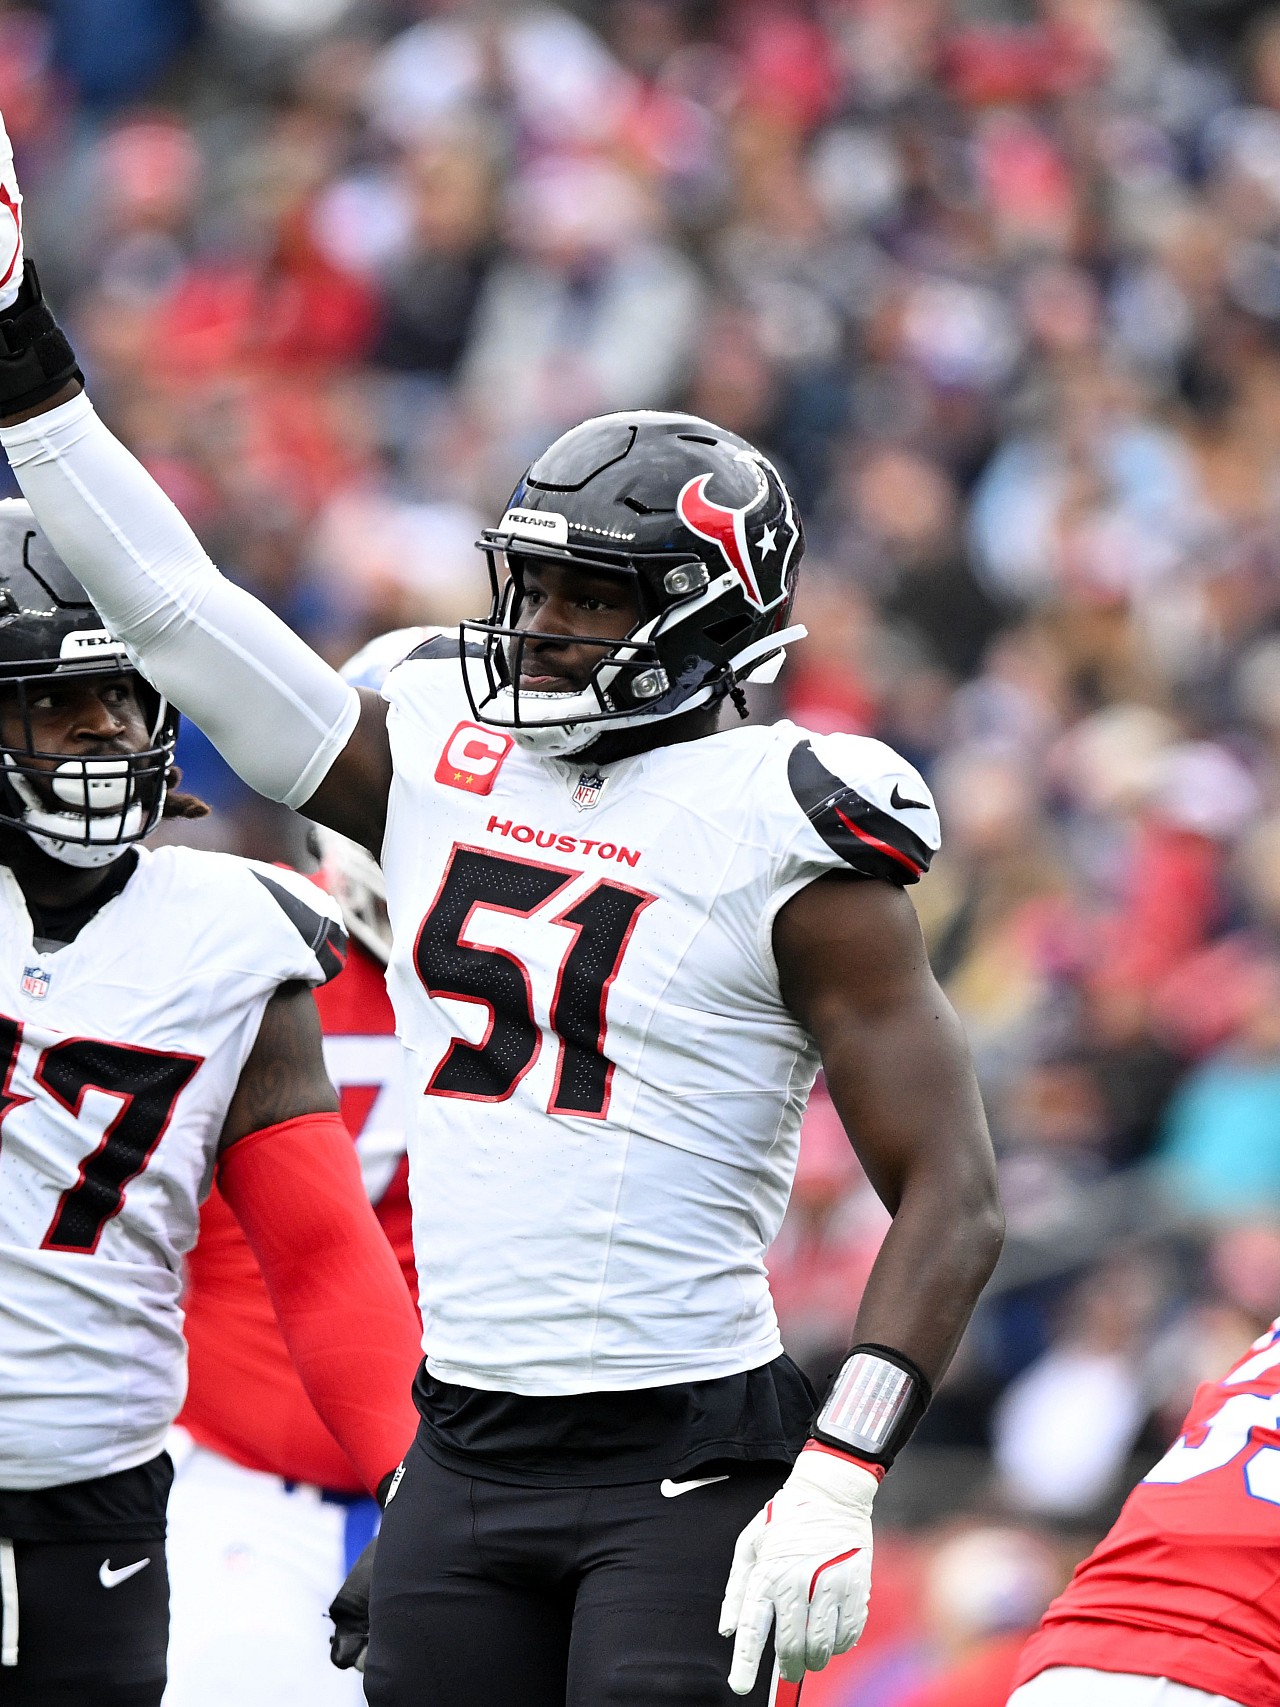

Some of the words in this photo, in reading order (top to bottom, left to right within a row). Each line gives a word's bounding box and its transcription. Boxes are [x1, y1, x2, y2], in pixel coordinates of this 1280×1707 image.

[508, 513, 557, 529] TEXANS
[446, 725, 507, 776] C
[574, 785, 597, 804] NFL
[486, 815, 642, 868] HOUSTON
[23, 976, 48, 996] NFL
[412, 841, 660, 1121] 51
